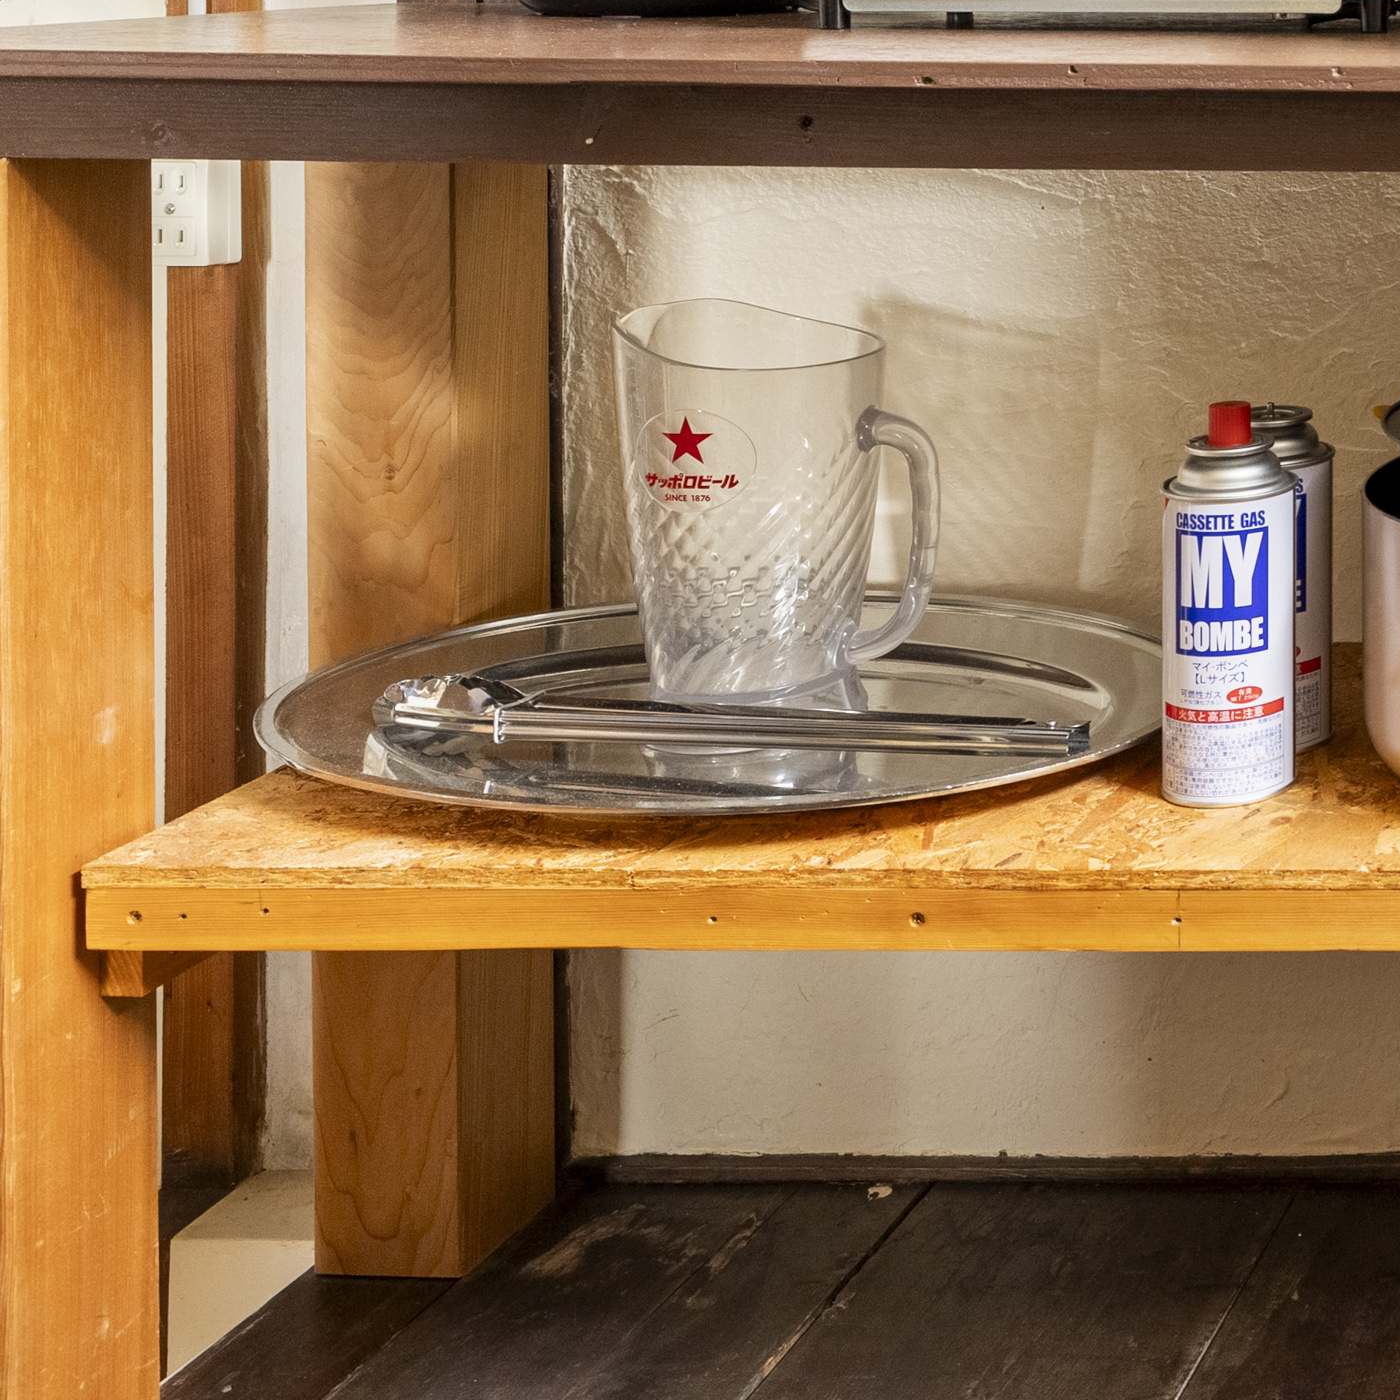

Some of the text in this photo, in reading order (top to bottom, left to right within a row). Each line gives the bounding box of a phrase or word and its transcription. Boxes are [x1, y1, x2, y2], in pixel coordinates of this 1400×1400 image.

[645, 472, 739, 490] サッポロビール
[664, 494, 711, 502] SINCE 1876
[1176, 510, 1266, 530] CASSETTE GAS
[1180, 531, 1264, 609] MY
[1179, 616, 1264, 653] BOMBE
[1180, 688, 1222, 700] 可燃性ガス
[1178, 706, 1265, 723] 火気と高温に注意
